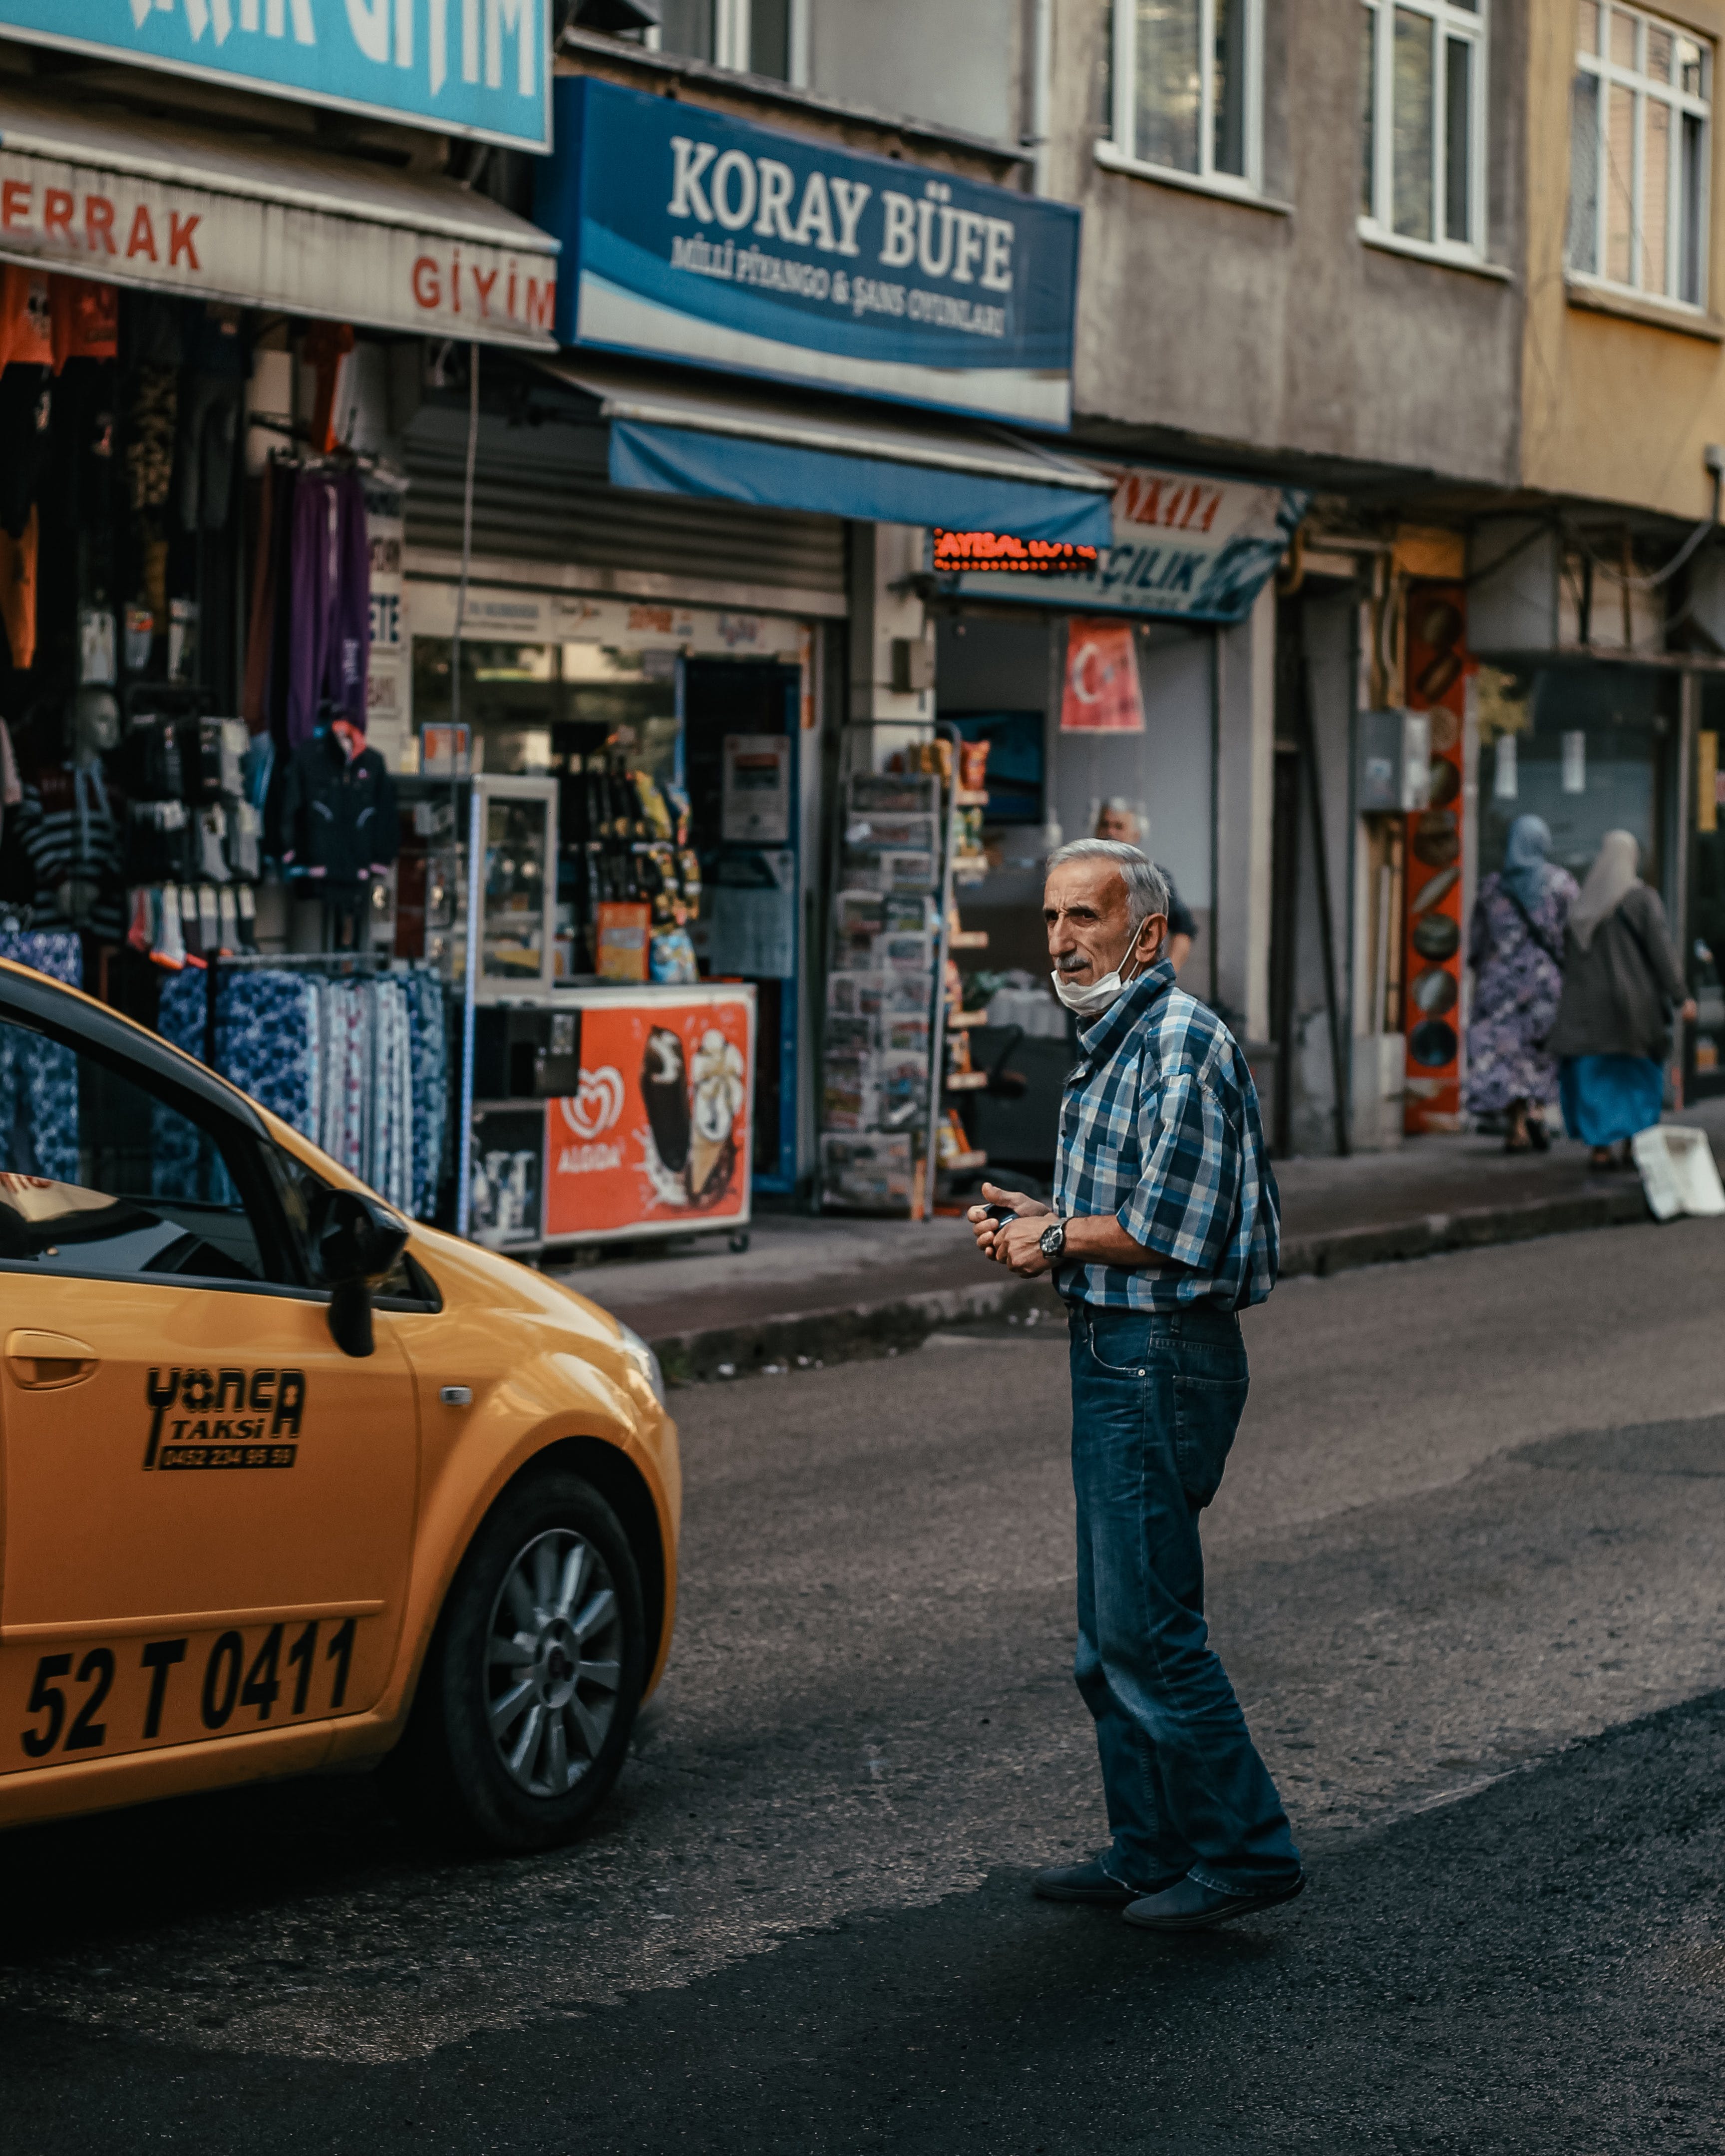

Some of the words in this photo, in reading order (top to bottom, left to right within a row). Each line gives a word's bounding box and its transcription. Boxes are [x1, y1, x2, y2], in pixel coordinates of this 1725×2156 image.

[667, 135, 872, 257] KORAY
[879, 180, 1015, 293] BÜFE
[670, 232, 734, 280] MİLLİ
[735, 244, 830, 300] PİYANGO
[831, 270, 849, 305] &
[851, 275, 907, 316] ŞANS
[21, 1647, 116, 1758] 52
[140, 1637, 189, 1740] T
[202, 1617, 357, 1730] 0411
